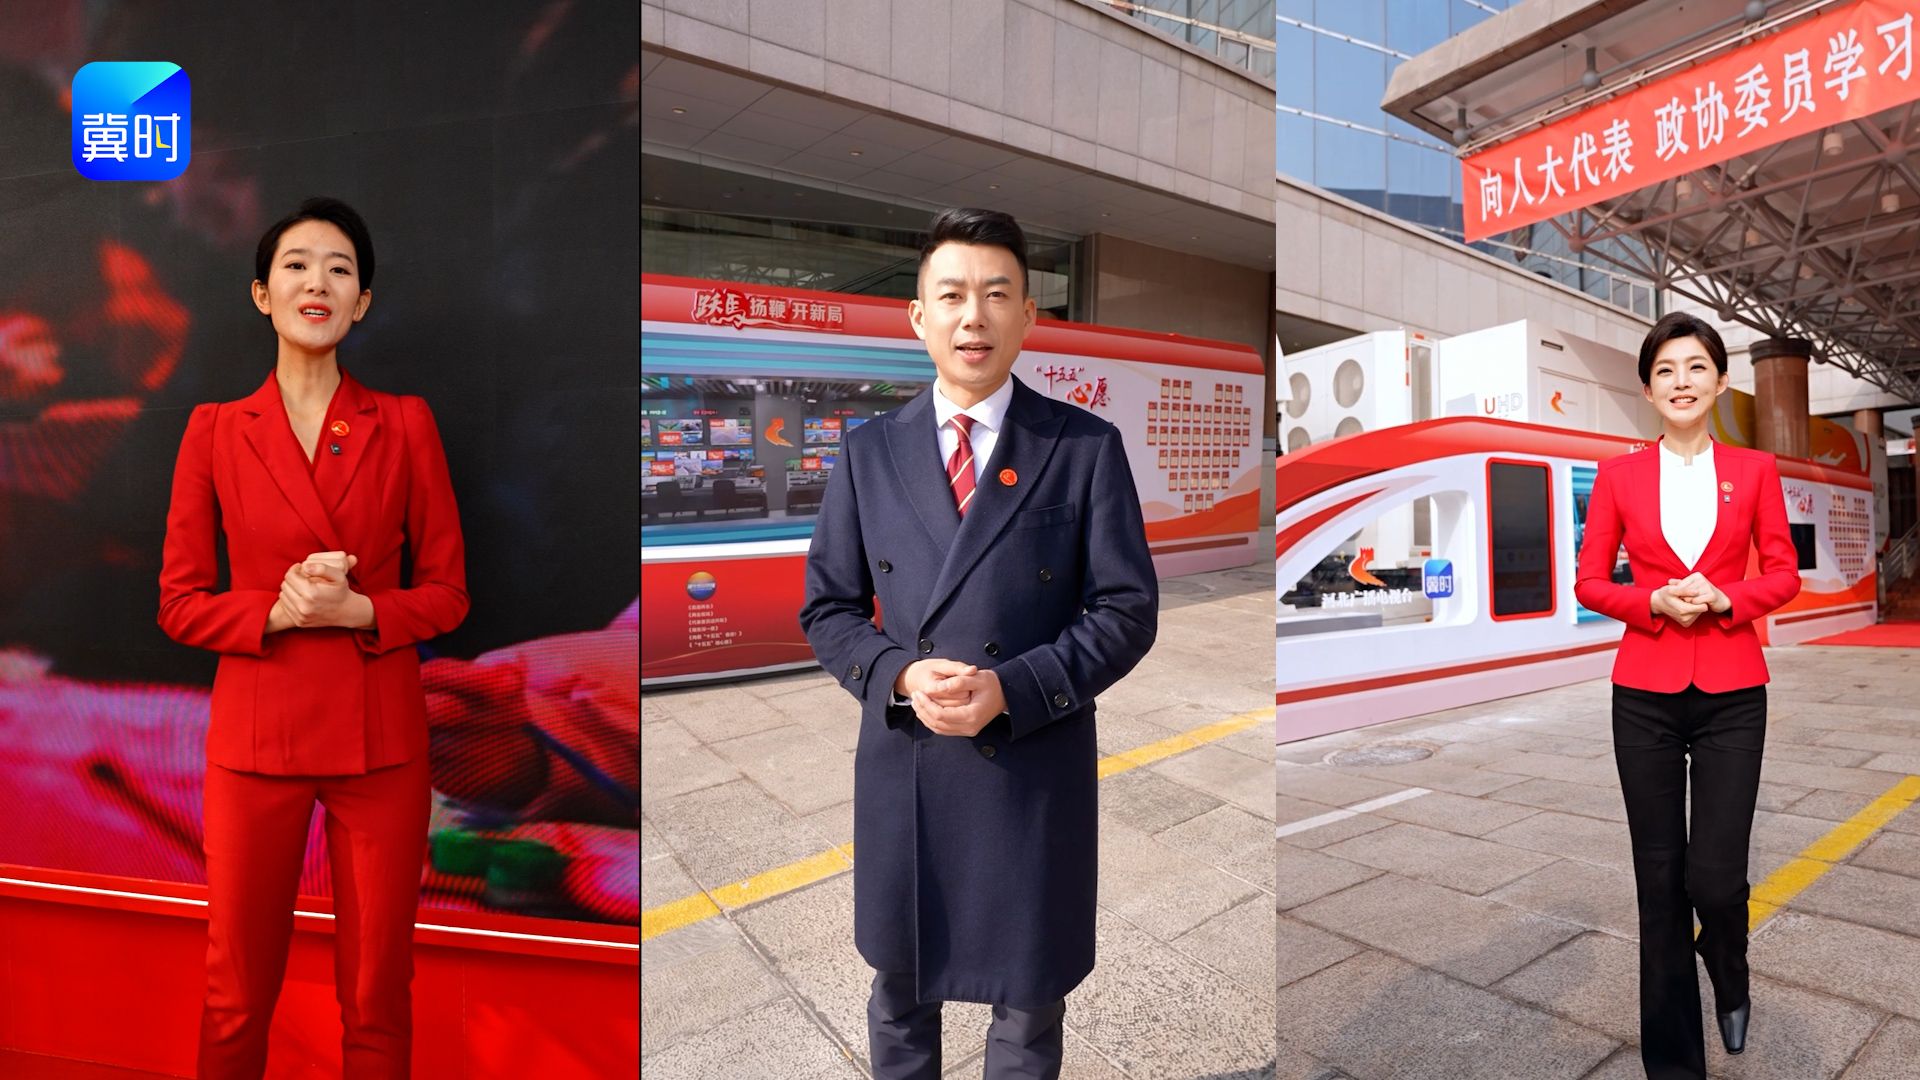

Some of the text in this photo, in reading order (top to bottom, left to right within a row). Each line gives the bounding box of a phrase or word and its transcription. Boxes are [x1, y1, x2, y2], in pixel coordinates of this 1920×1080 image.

[1480, 12, 1914, 221] 向人大代表 政协委员学习
[792, 302, 843, 323] 开新局
[1067, 377, 1111, 409] 心愿
